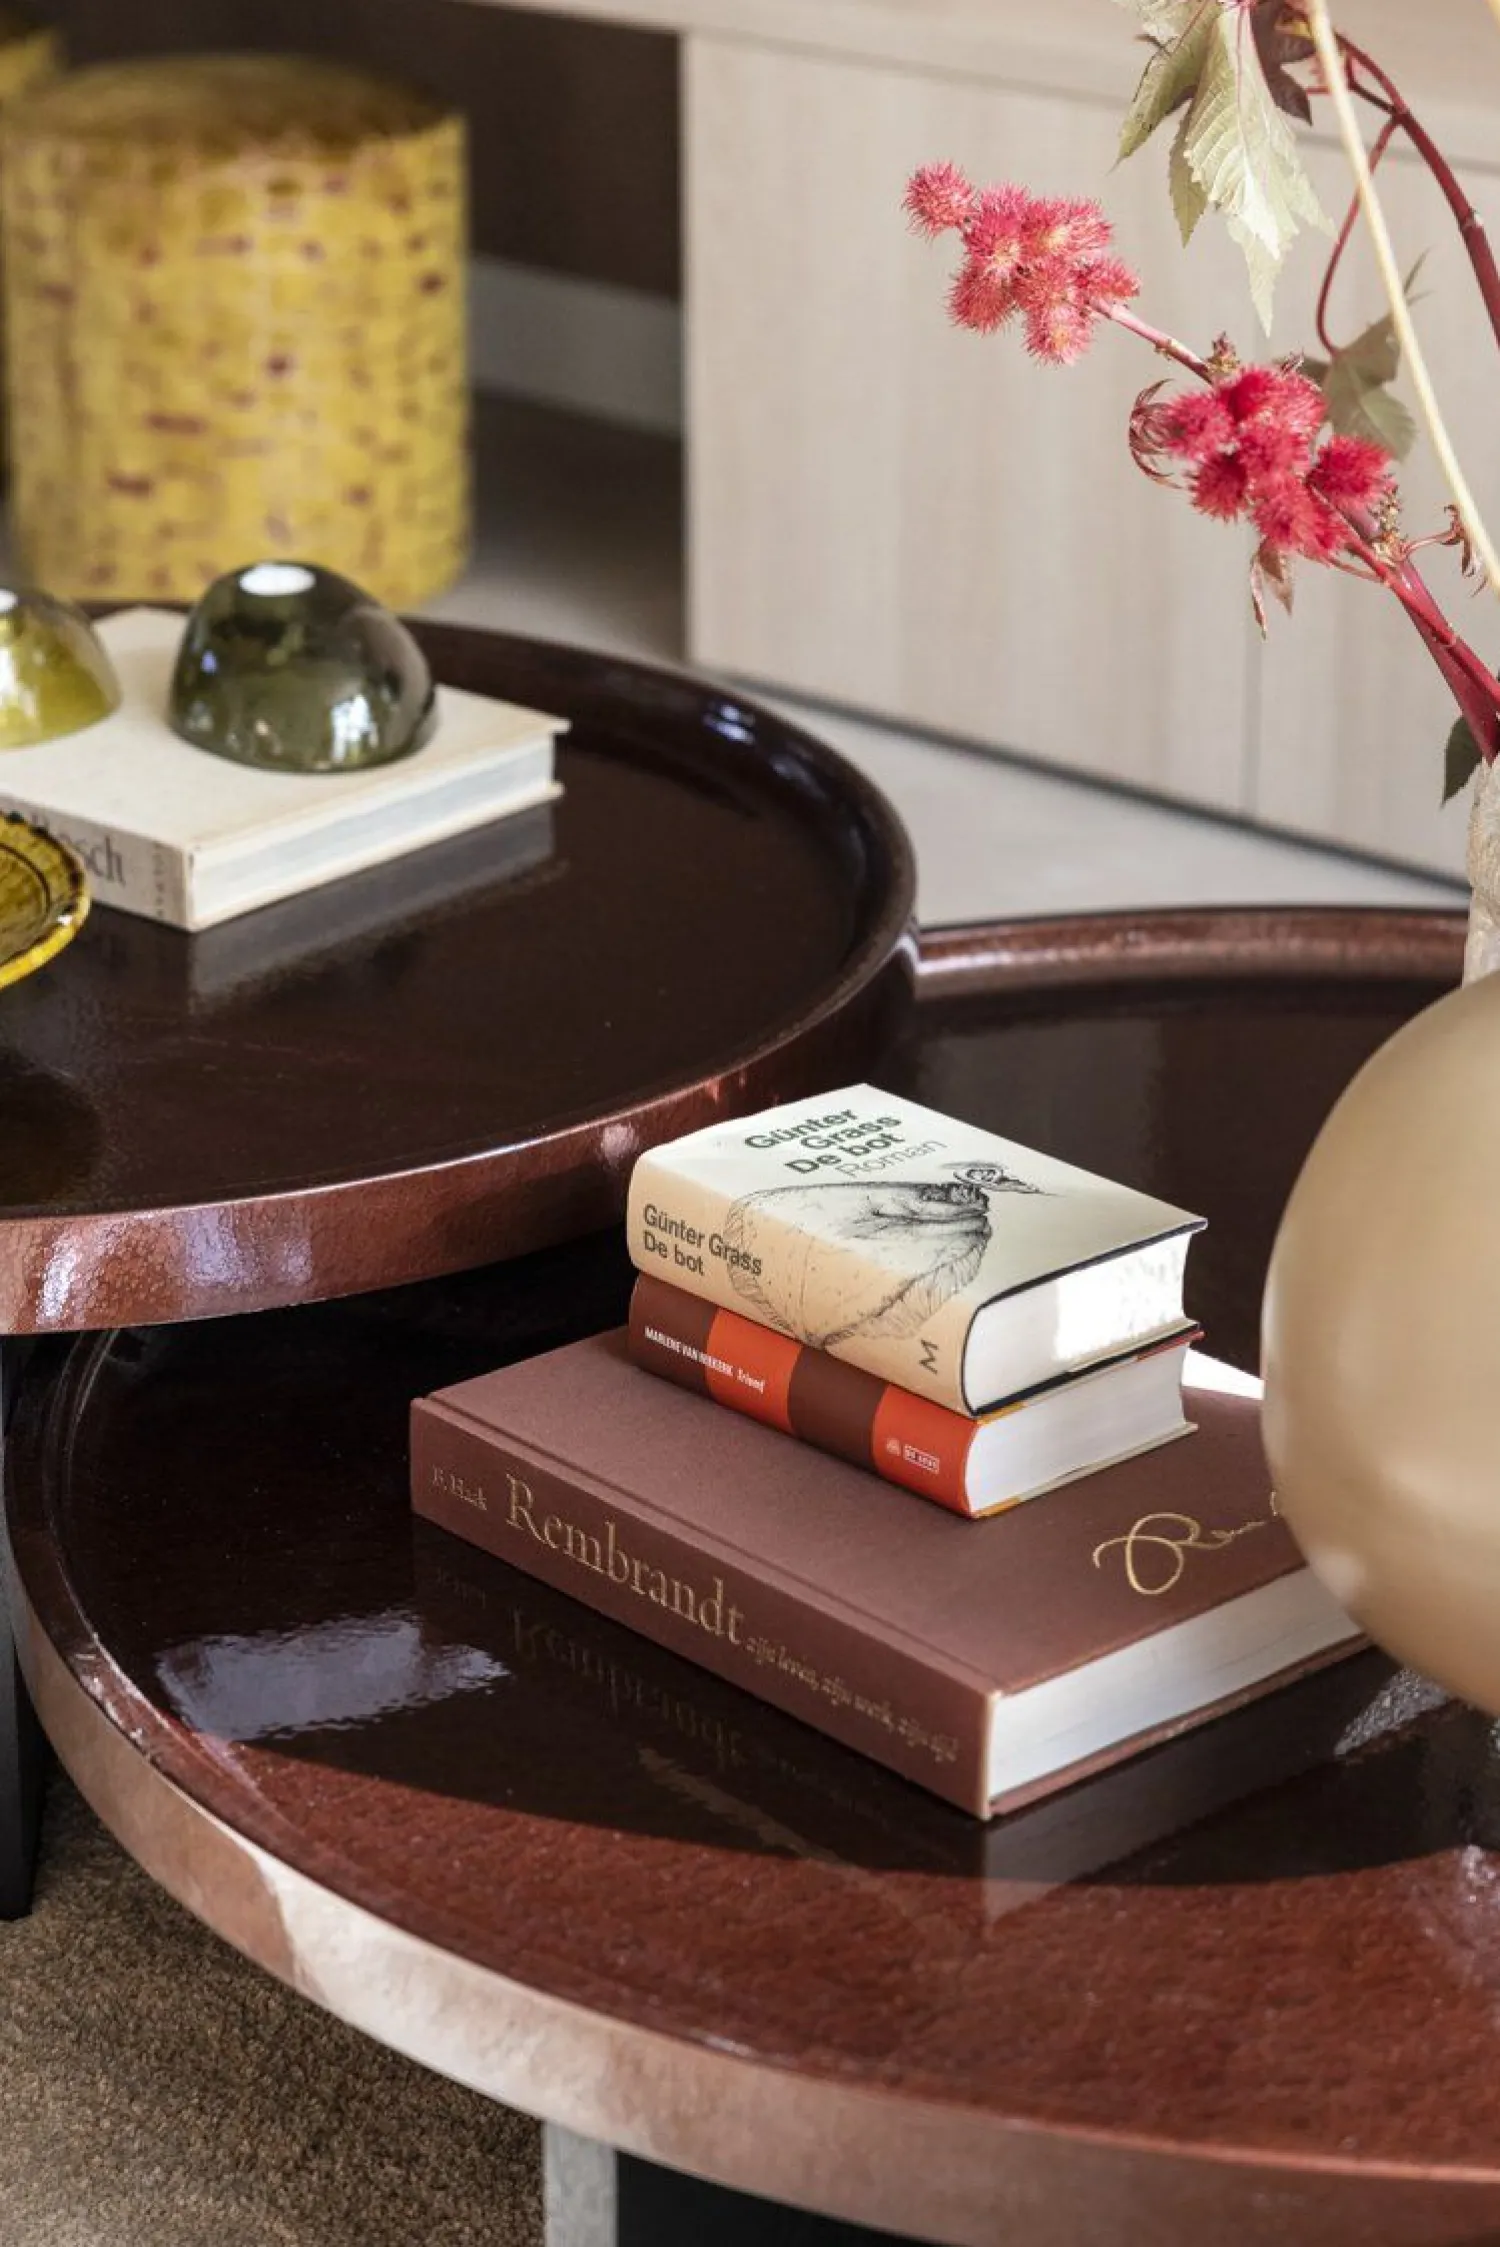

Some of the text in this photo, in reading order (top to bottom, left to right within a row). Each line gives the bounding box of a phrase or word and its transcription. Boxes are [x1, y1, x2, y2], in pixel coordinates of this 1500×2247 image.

[744, 1108, 858, 1149] Günter
[800, 1116, 902, 1150] Grass
[784, 1132, 905, 1174] De bot
[835, 1140, 948, 1178] Roman
[643, 1203, 762, 1277] Günter Grass
[643, 1230, 705, 1277] De bot
[644, 1325, 681, 1354] MARLENE
[682, 1344, 698, 1361] VAN
[918, 1338, 939, 1376] M
[505, 1472, 741, 1644] Rembrandt
